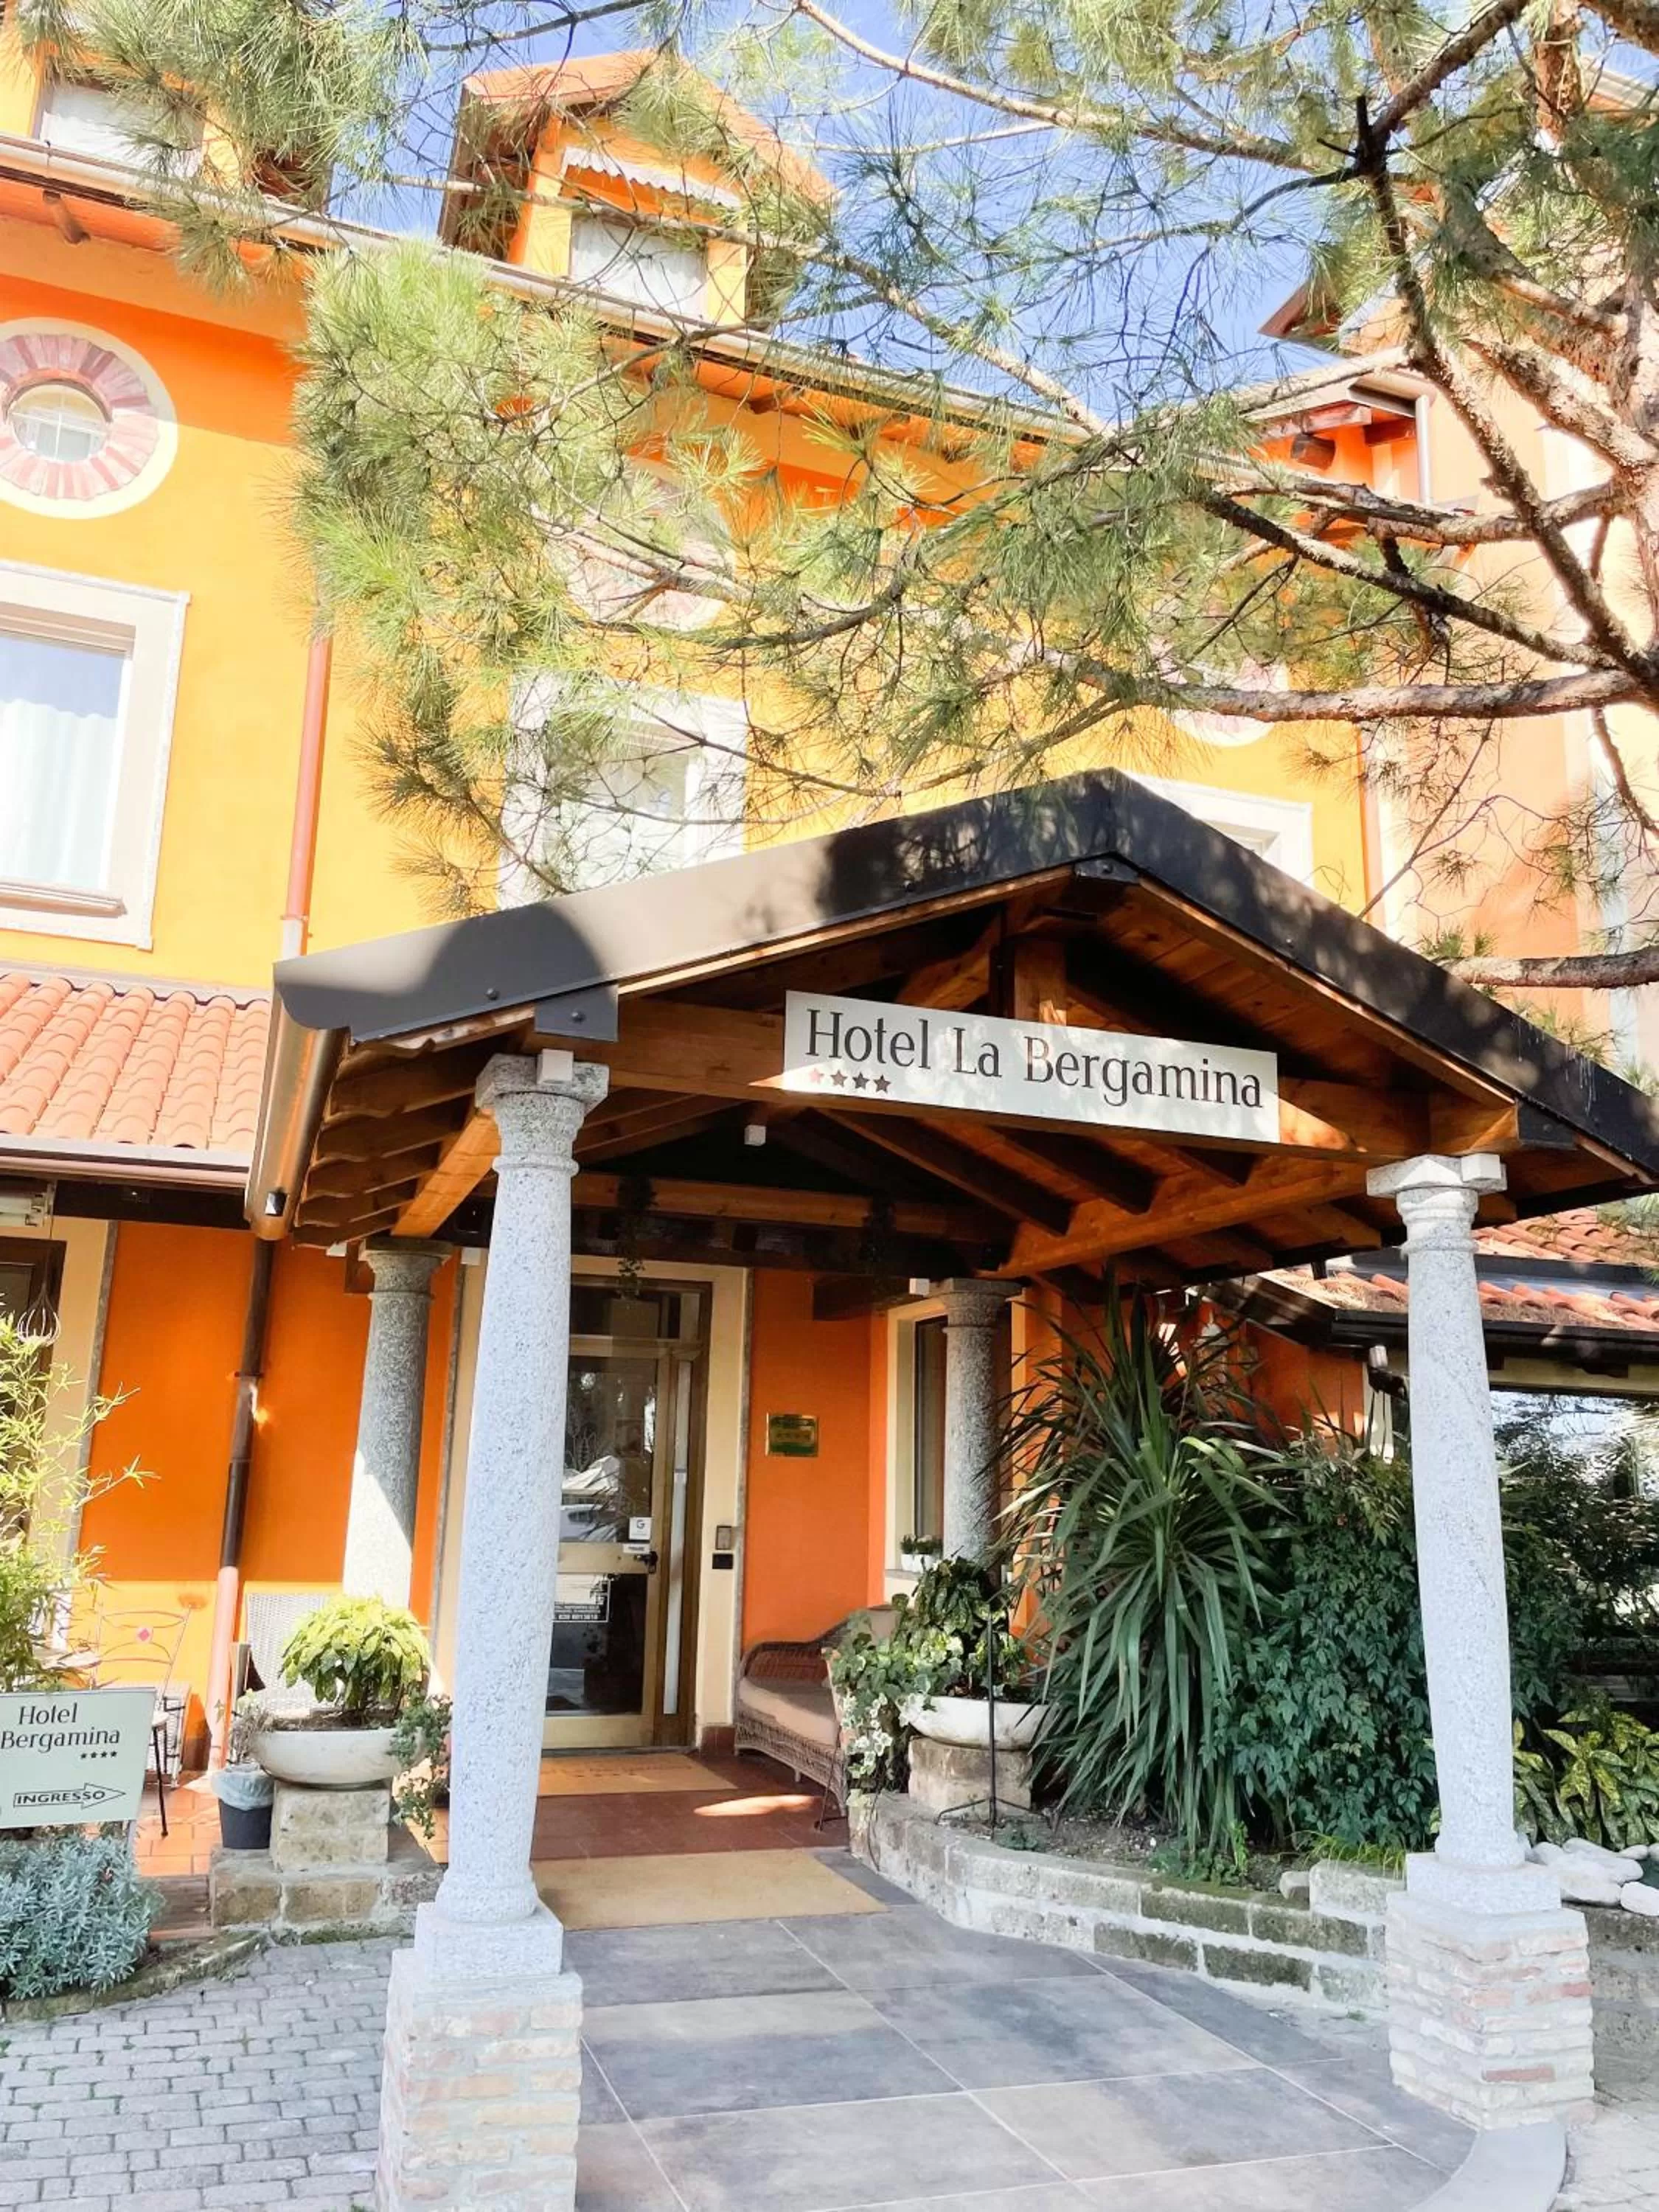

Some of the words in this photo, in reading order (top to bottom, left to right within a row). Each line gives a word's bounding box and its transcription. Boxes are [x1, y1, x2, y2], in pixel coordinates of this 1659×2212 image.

[805, 1008, 931, 1070] Hotel
[953, 1027, 1003, 1078] La
[1023, 1036, 1263, 1108] Bergamina
[18, 1702, 77, 1725] Hotel
[0, 1726, 120, 1753] Bergamina
[16, 1790, 105, 1804] INGRESSO
